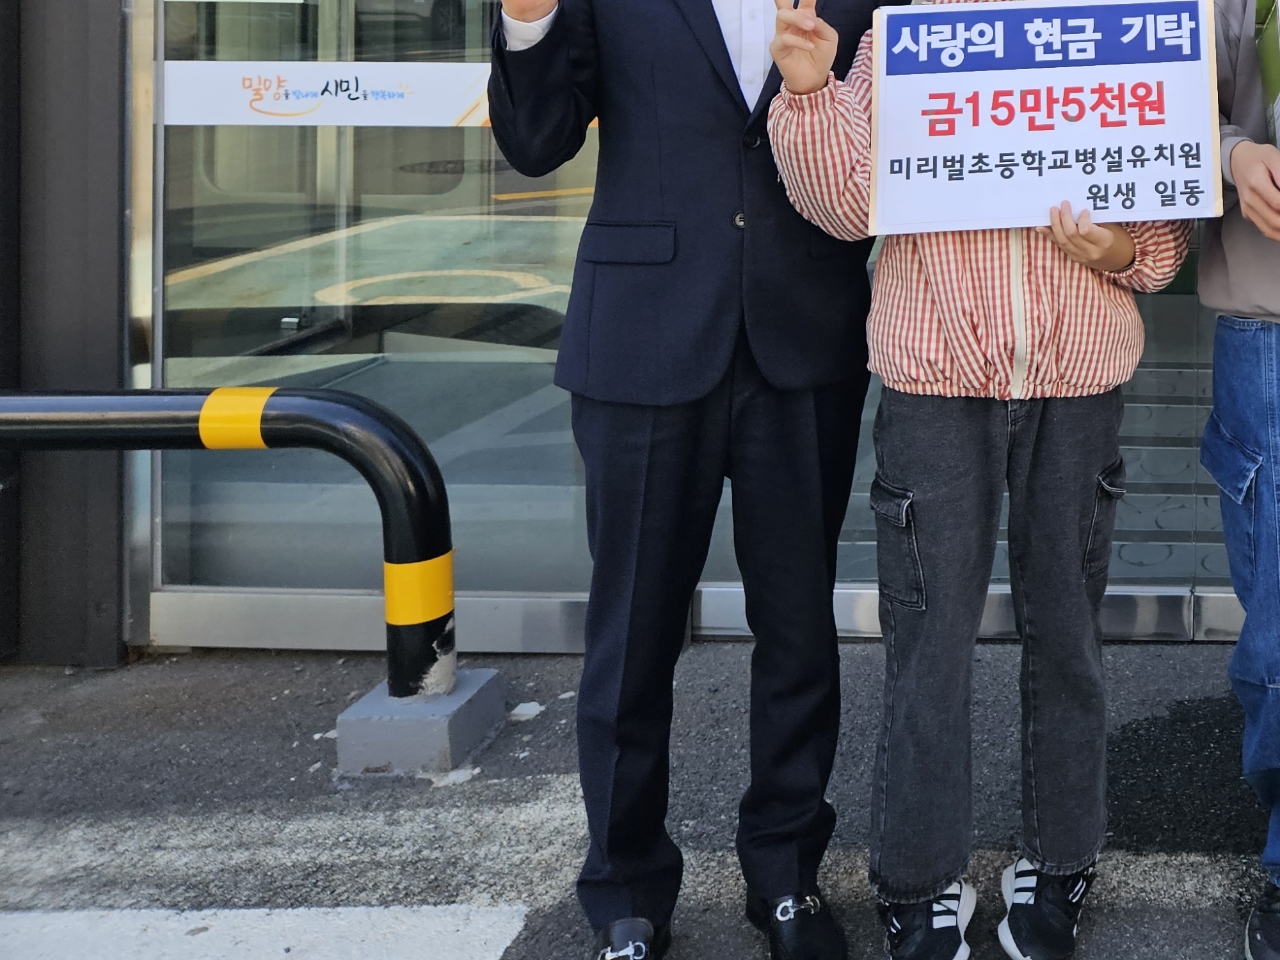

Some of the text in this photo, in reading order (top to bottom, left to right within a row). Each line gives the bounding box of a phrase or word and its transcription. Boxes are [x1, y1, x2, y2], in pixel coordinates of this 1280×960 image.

[891, 12, 1196, 68] 사랑의 현금 기탁
[920, 80, 1166, 138] 금15만5천원
[889, 141, 1203, 182] 미리벌초등학교병설유치원
[1085, 178, 1205, 211] 원생 일동
